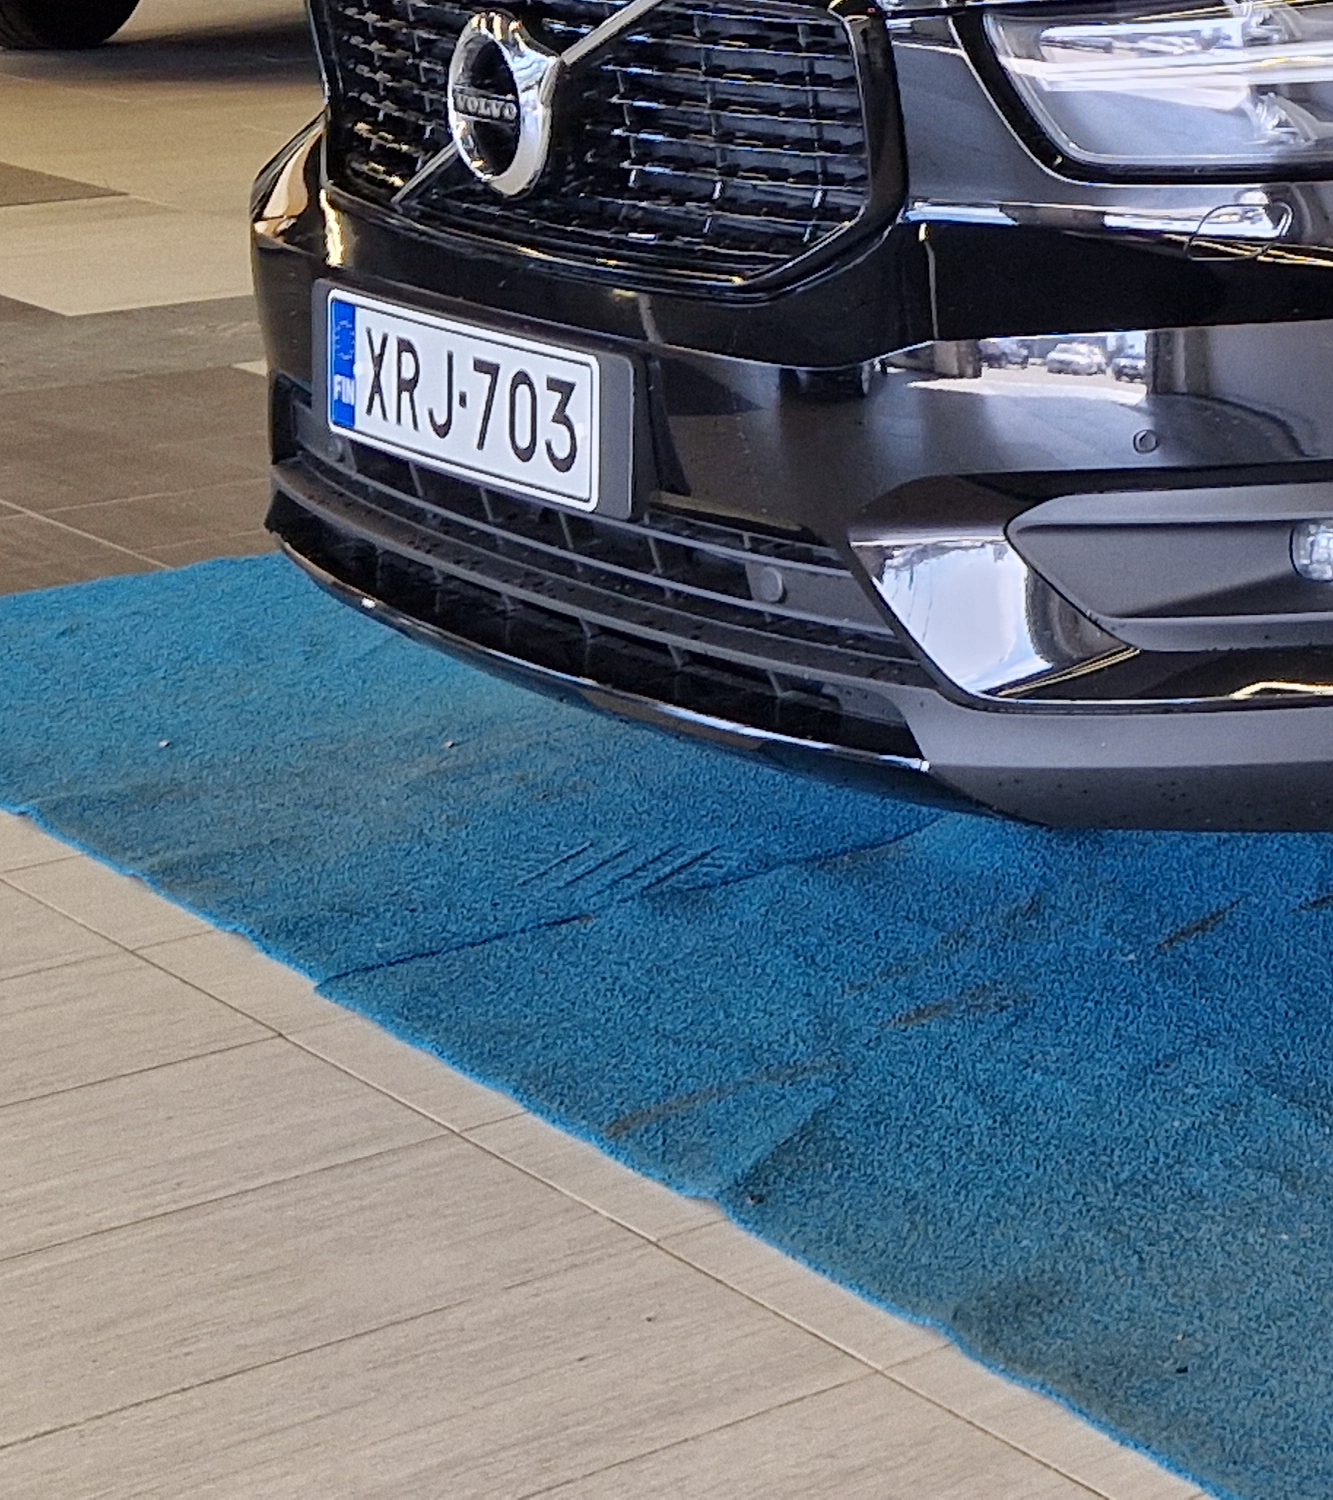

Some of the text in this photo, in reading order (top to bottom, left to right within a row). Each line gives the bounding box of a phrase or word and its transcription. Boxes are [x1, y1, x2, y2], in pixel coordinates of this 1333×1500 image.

[454, 93, 517, 120] VOLVO
[333, 374, 356, 406] FIN
[365, 326, 578, 473] XRJ-703
